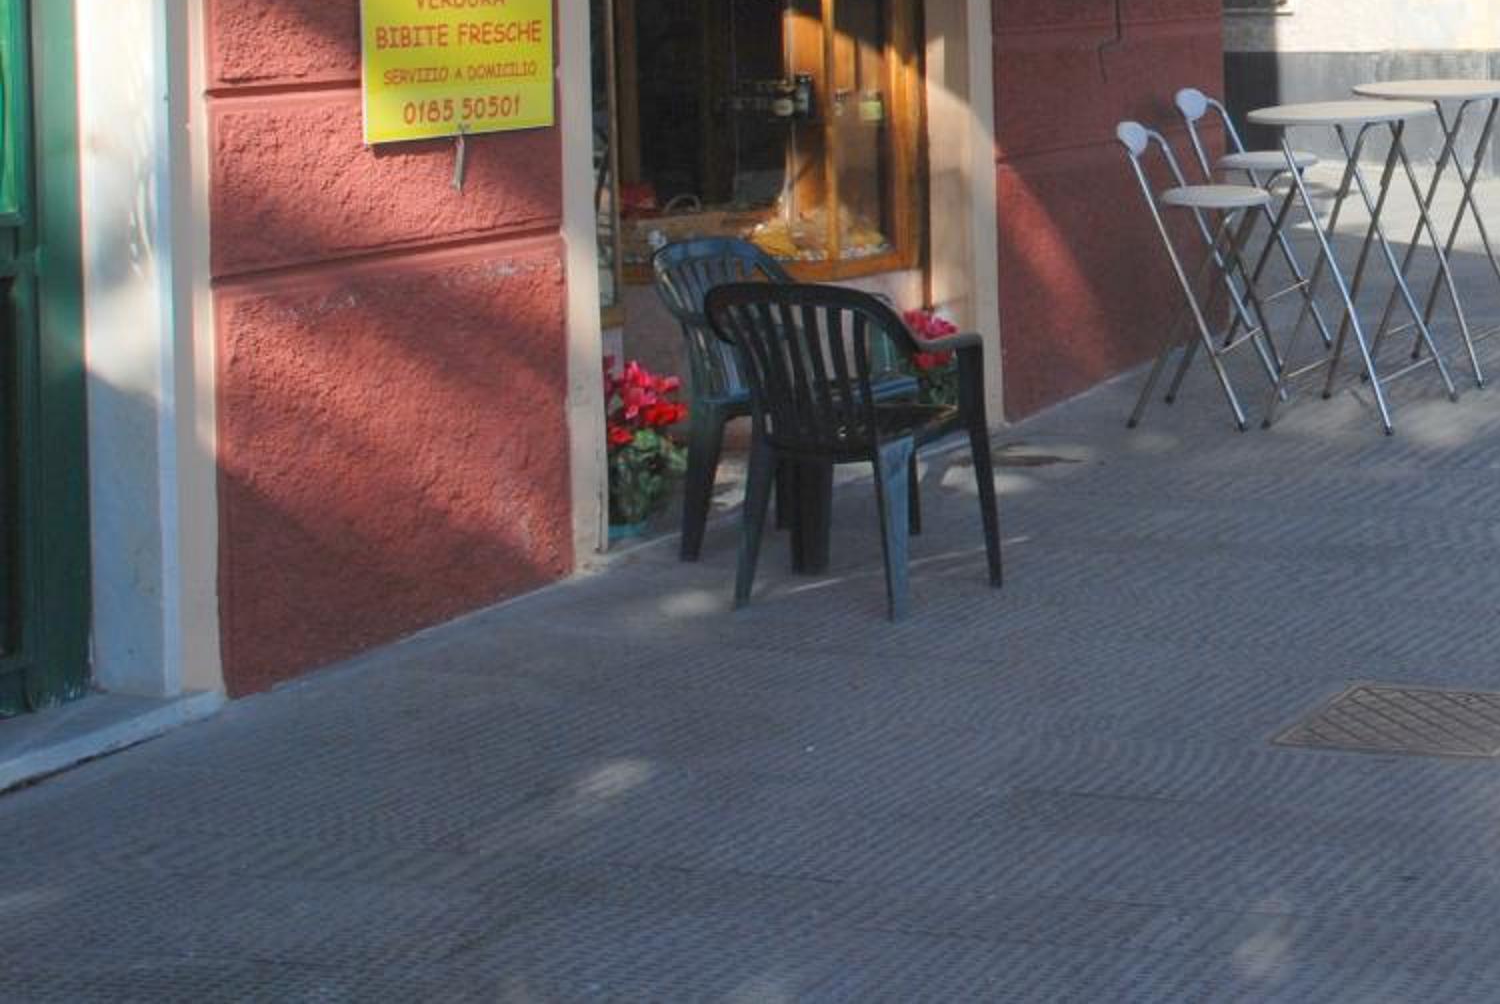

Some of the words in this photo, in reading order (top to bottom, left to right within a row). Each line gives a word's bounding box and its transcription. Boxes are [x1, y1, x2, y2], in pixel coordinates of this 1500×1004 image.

[375, 24, 449, 49] BIBITE
[458, 19, 543, 45] FRESCHE
[383, 66, 449, 85] SERVIZIO
[453, 70, 463, 81] A
[467, 60, 537, 81] DOMICILIO
[403, 99, 454, 125] 0185
[461, 95, 520, 120] 50501
